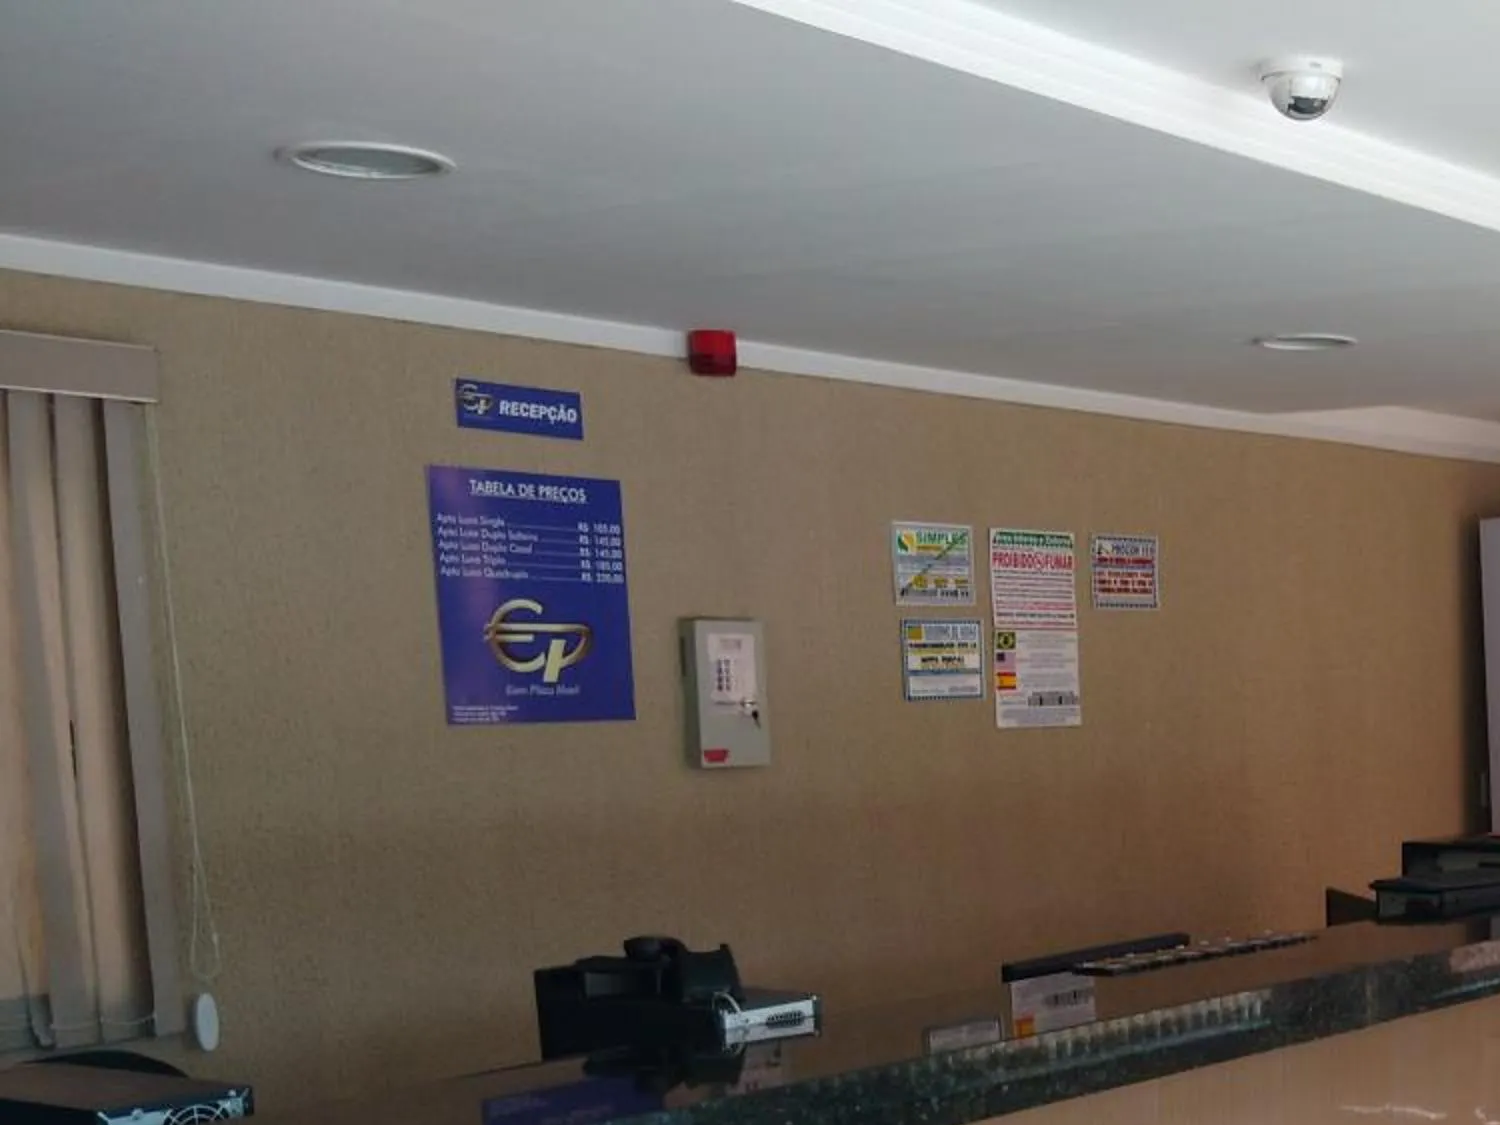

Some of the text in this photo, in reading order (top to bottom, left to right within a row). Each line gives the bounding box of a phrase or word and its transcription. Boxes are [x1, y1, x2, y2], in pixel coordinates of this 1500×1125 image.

[499, 399, 578, 424] RECEPÇÃO
[468, 479, 588, 504] TABELA DE PREÇOS
